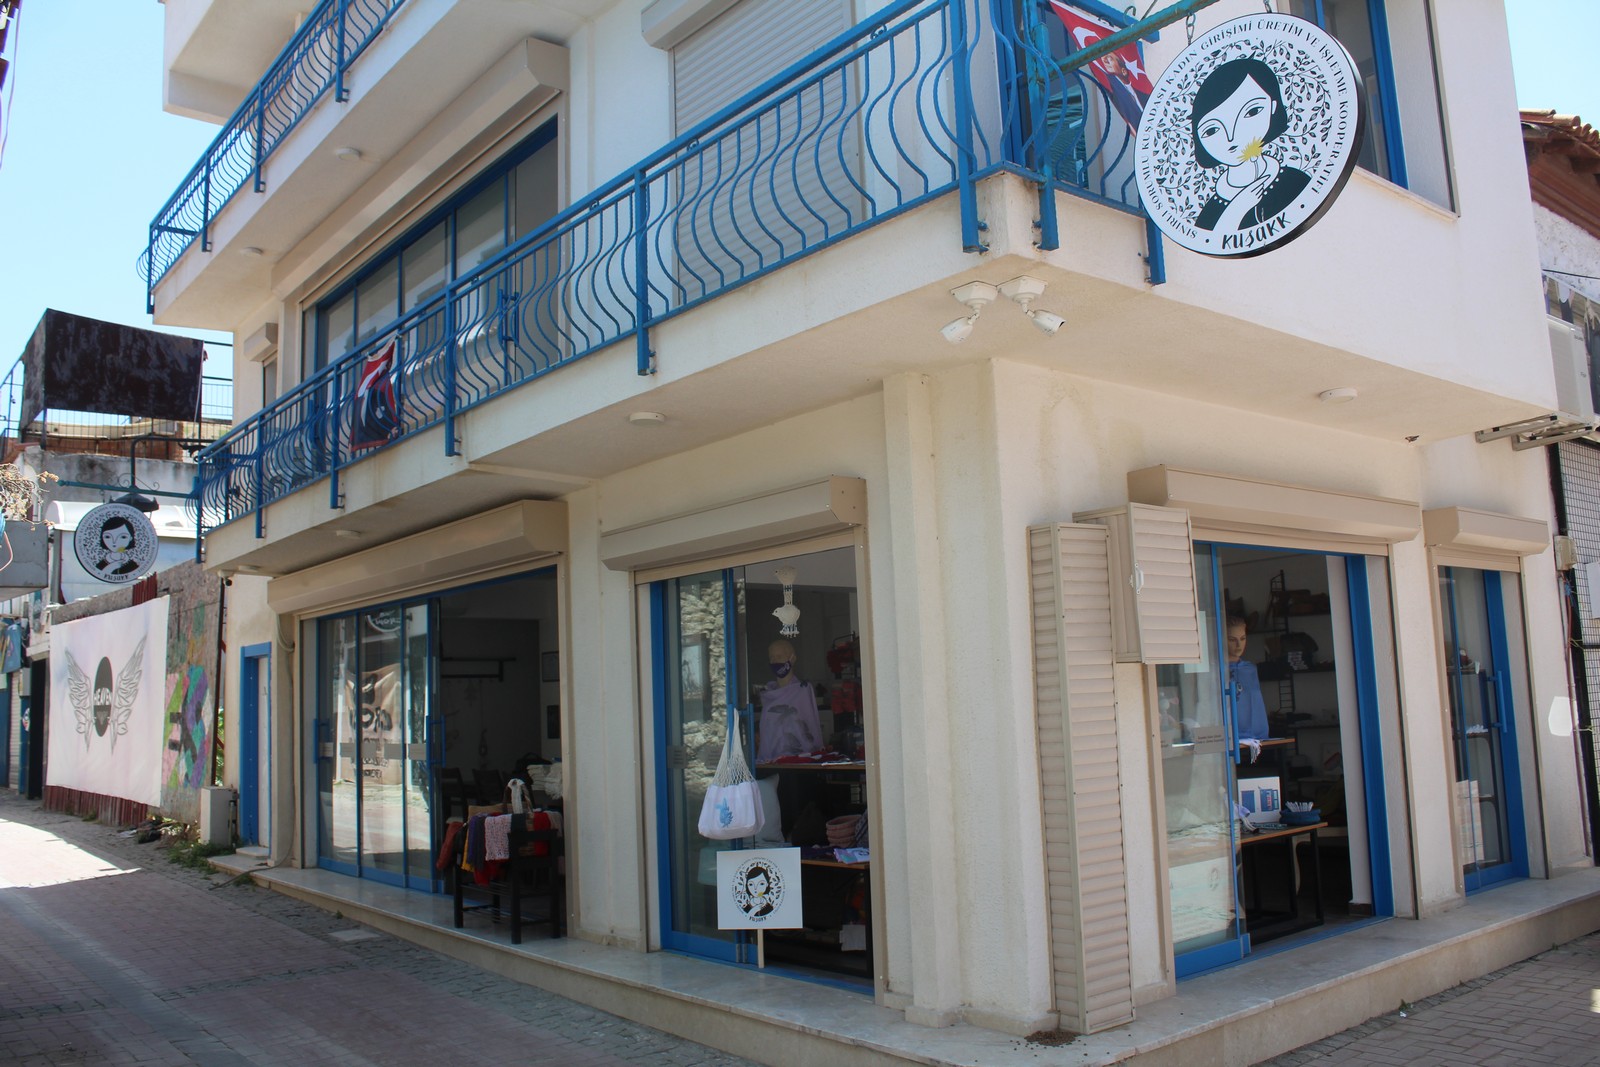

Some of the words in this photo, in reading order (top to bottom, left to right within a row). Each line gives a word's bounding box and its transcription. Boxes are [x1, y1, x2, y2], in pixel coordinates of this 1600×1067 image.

[1200, 20, 1252, 51] GİRİŞİMİ
[1257, 19, 1303, 37] ÜRETİM
[1305, 32, 1321, 48] VE
[1165, 49, 1198, 85] KADIN
[1318, 43, 1348, 96] İŞLETME
[1142, 87, 1167, 150] KUŞADASI
[1311, 100, 1349, 195] KOOPERATİFİ
[1141, 155, 1164, 211] SORUMLU
[1161, 210, 1197, 239] SINIRLI
